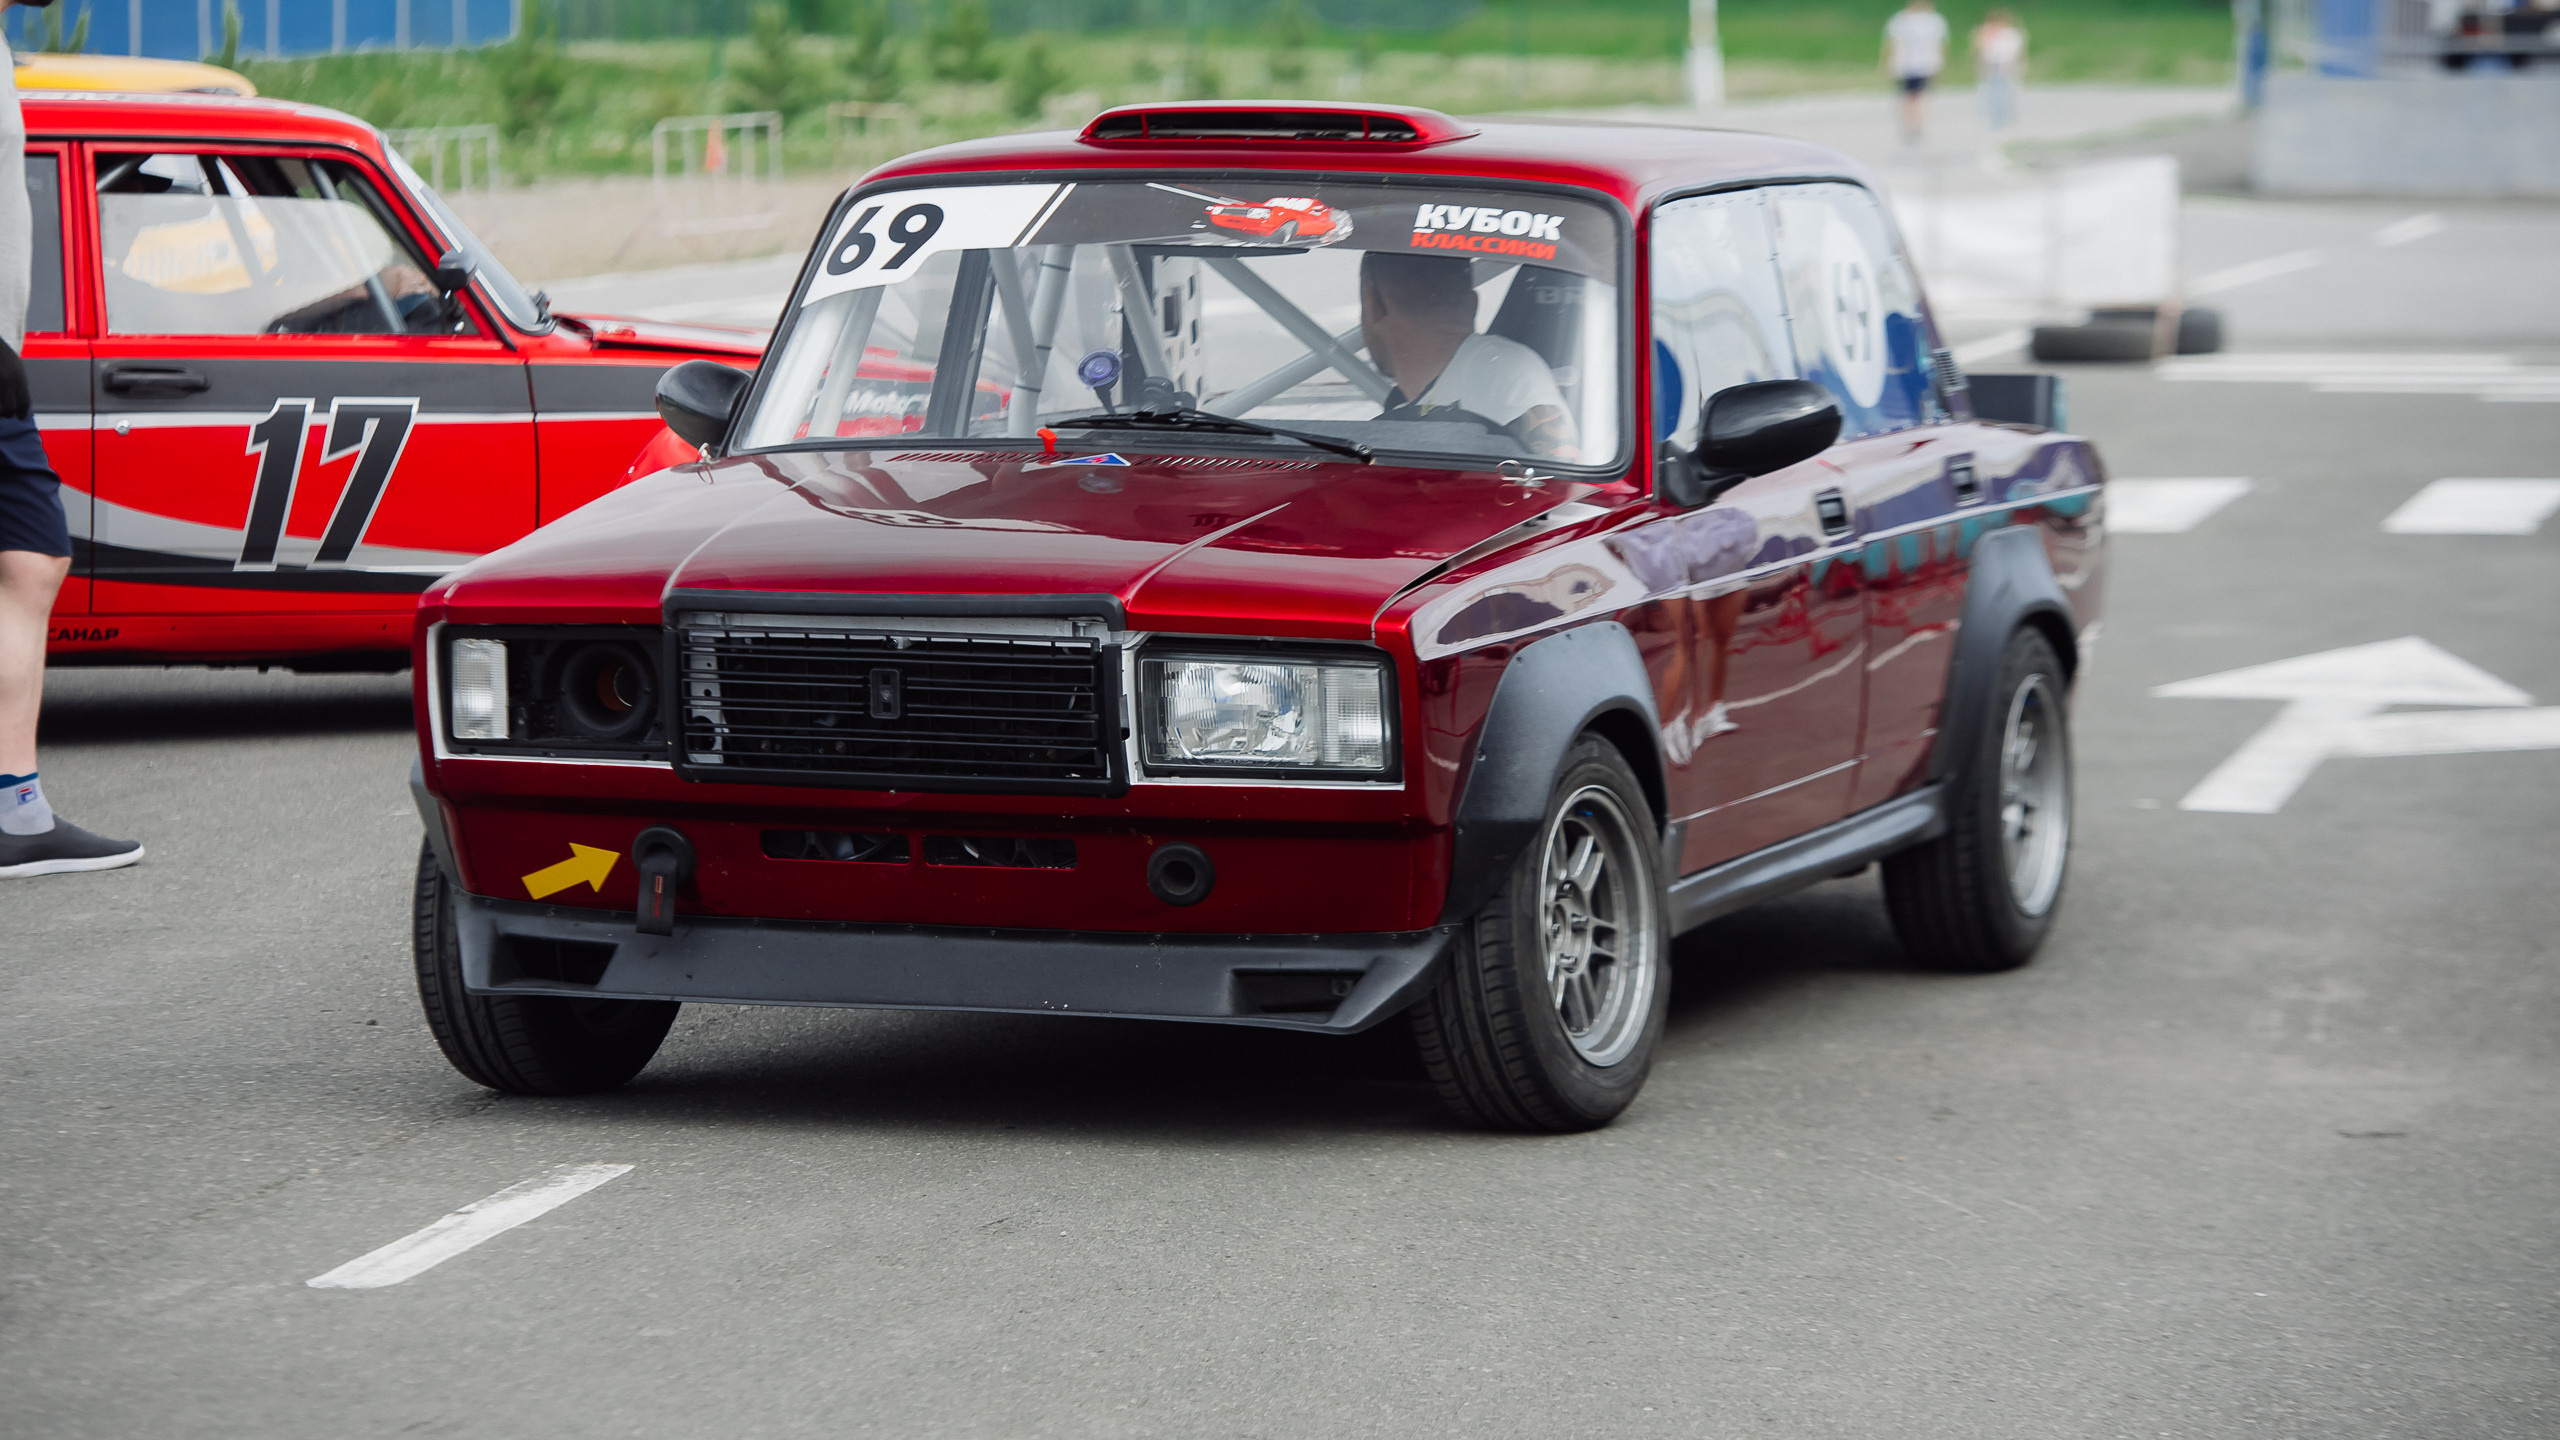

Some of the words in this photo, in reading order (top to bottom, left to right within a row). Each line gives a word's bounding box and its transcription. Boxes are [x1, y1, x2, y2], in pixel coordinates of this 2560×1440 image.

[827, 203, 944, 275] 69
[1410, 232, 1557, 260] КЛАССИКИ
[1414, 203, 1565, 241] КУБОК
[233, 396, 420, 571] 17
